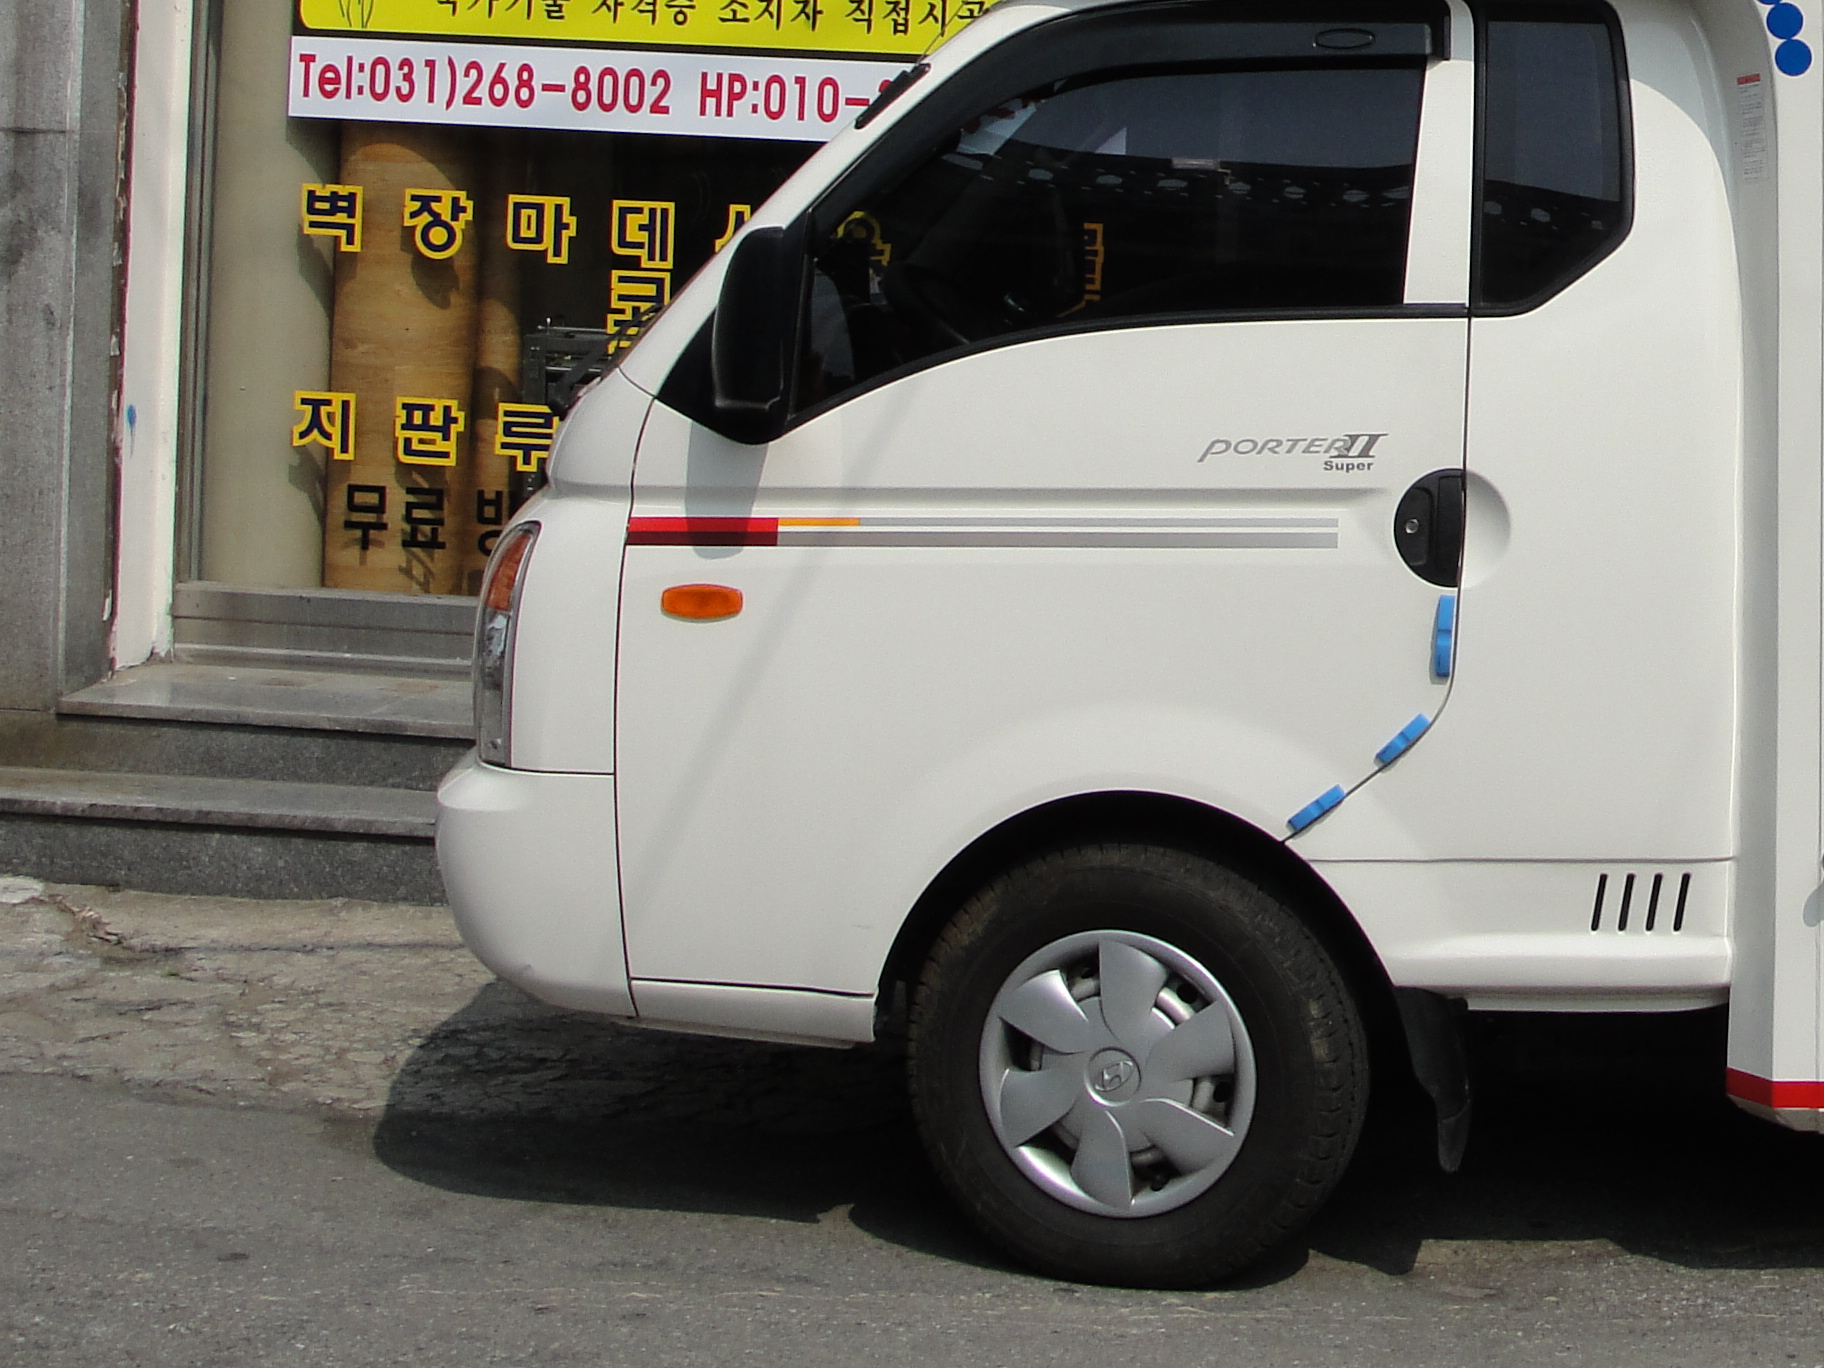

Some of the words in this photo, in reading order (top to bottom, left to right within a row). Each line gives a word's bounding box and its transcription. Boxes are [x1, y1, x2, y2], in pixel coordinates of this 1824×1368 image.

[298, 52, 672, 116] Tel:031)268-8002
[700, 71, 891, 124] HP:010-
[1323, 460, 1374, 474] Super
